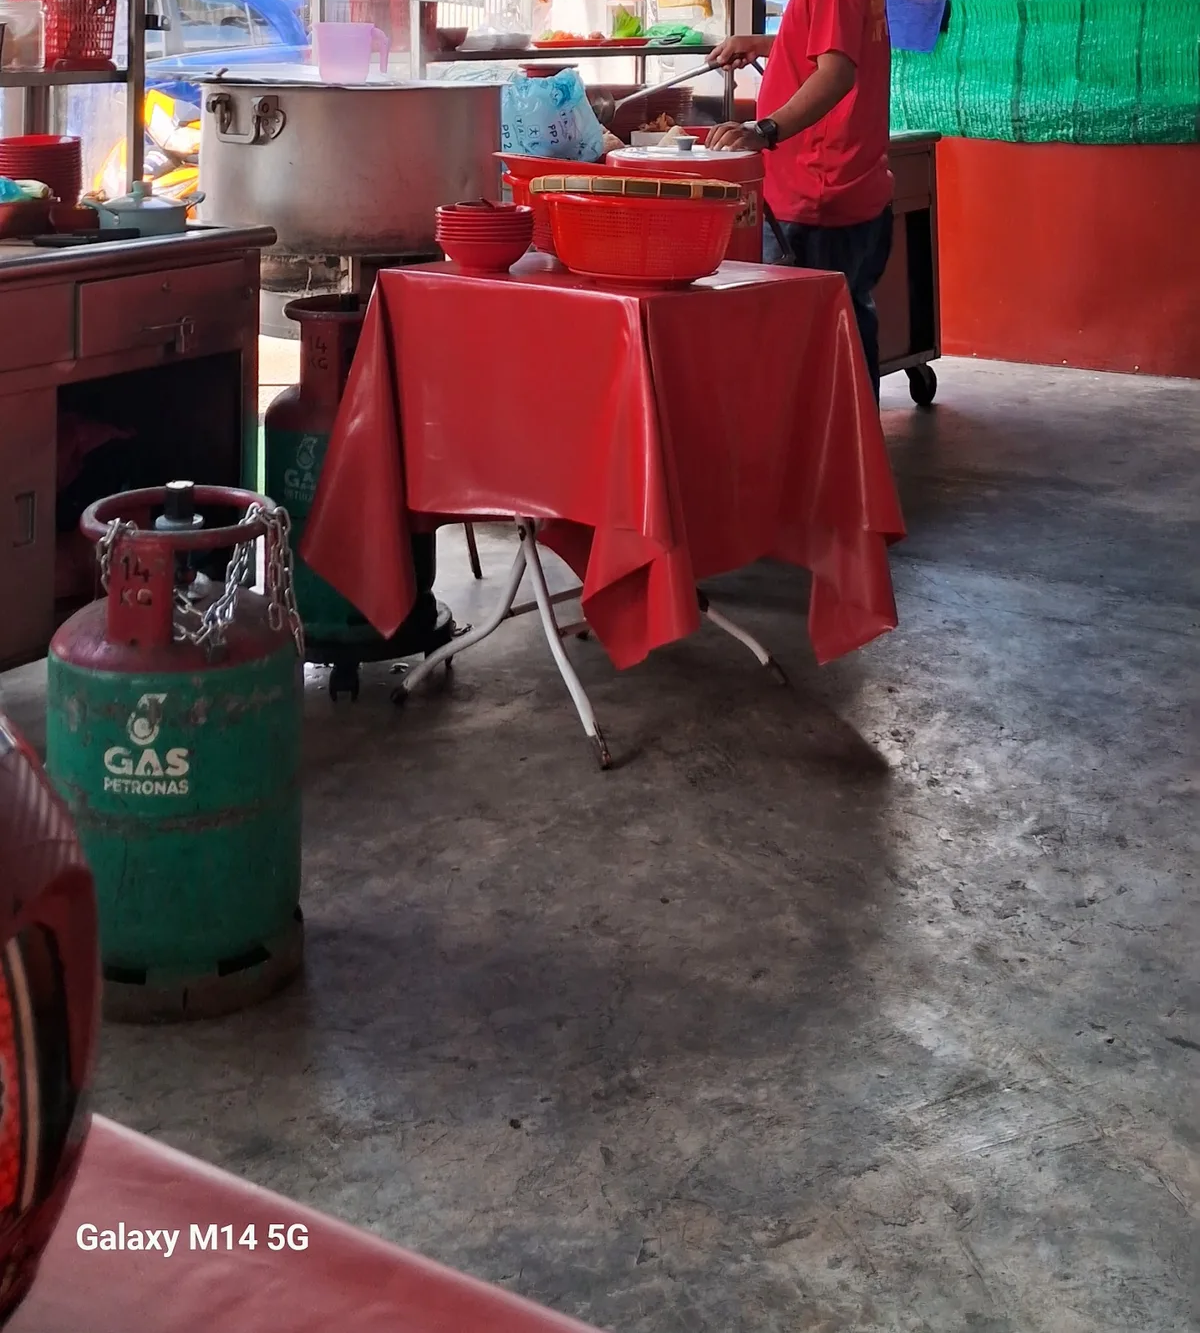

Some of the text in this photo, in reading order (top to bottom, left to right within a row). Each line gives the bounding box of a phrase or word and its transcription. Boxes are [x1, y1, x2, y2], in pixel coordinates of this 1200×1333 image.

[121, 554, 153, 583] 14
[103, 745, 190, 777] GAS
[103, 776, 190, 795] PETRONAS
